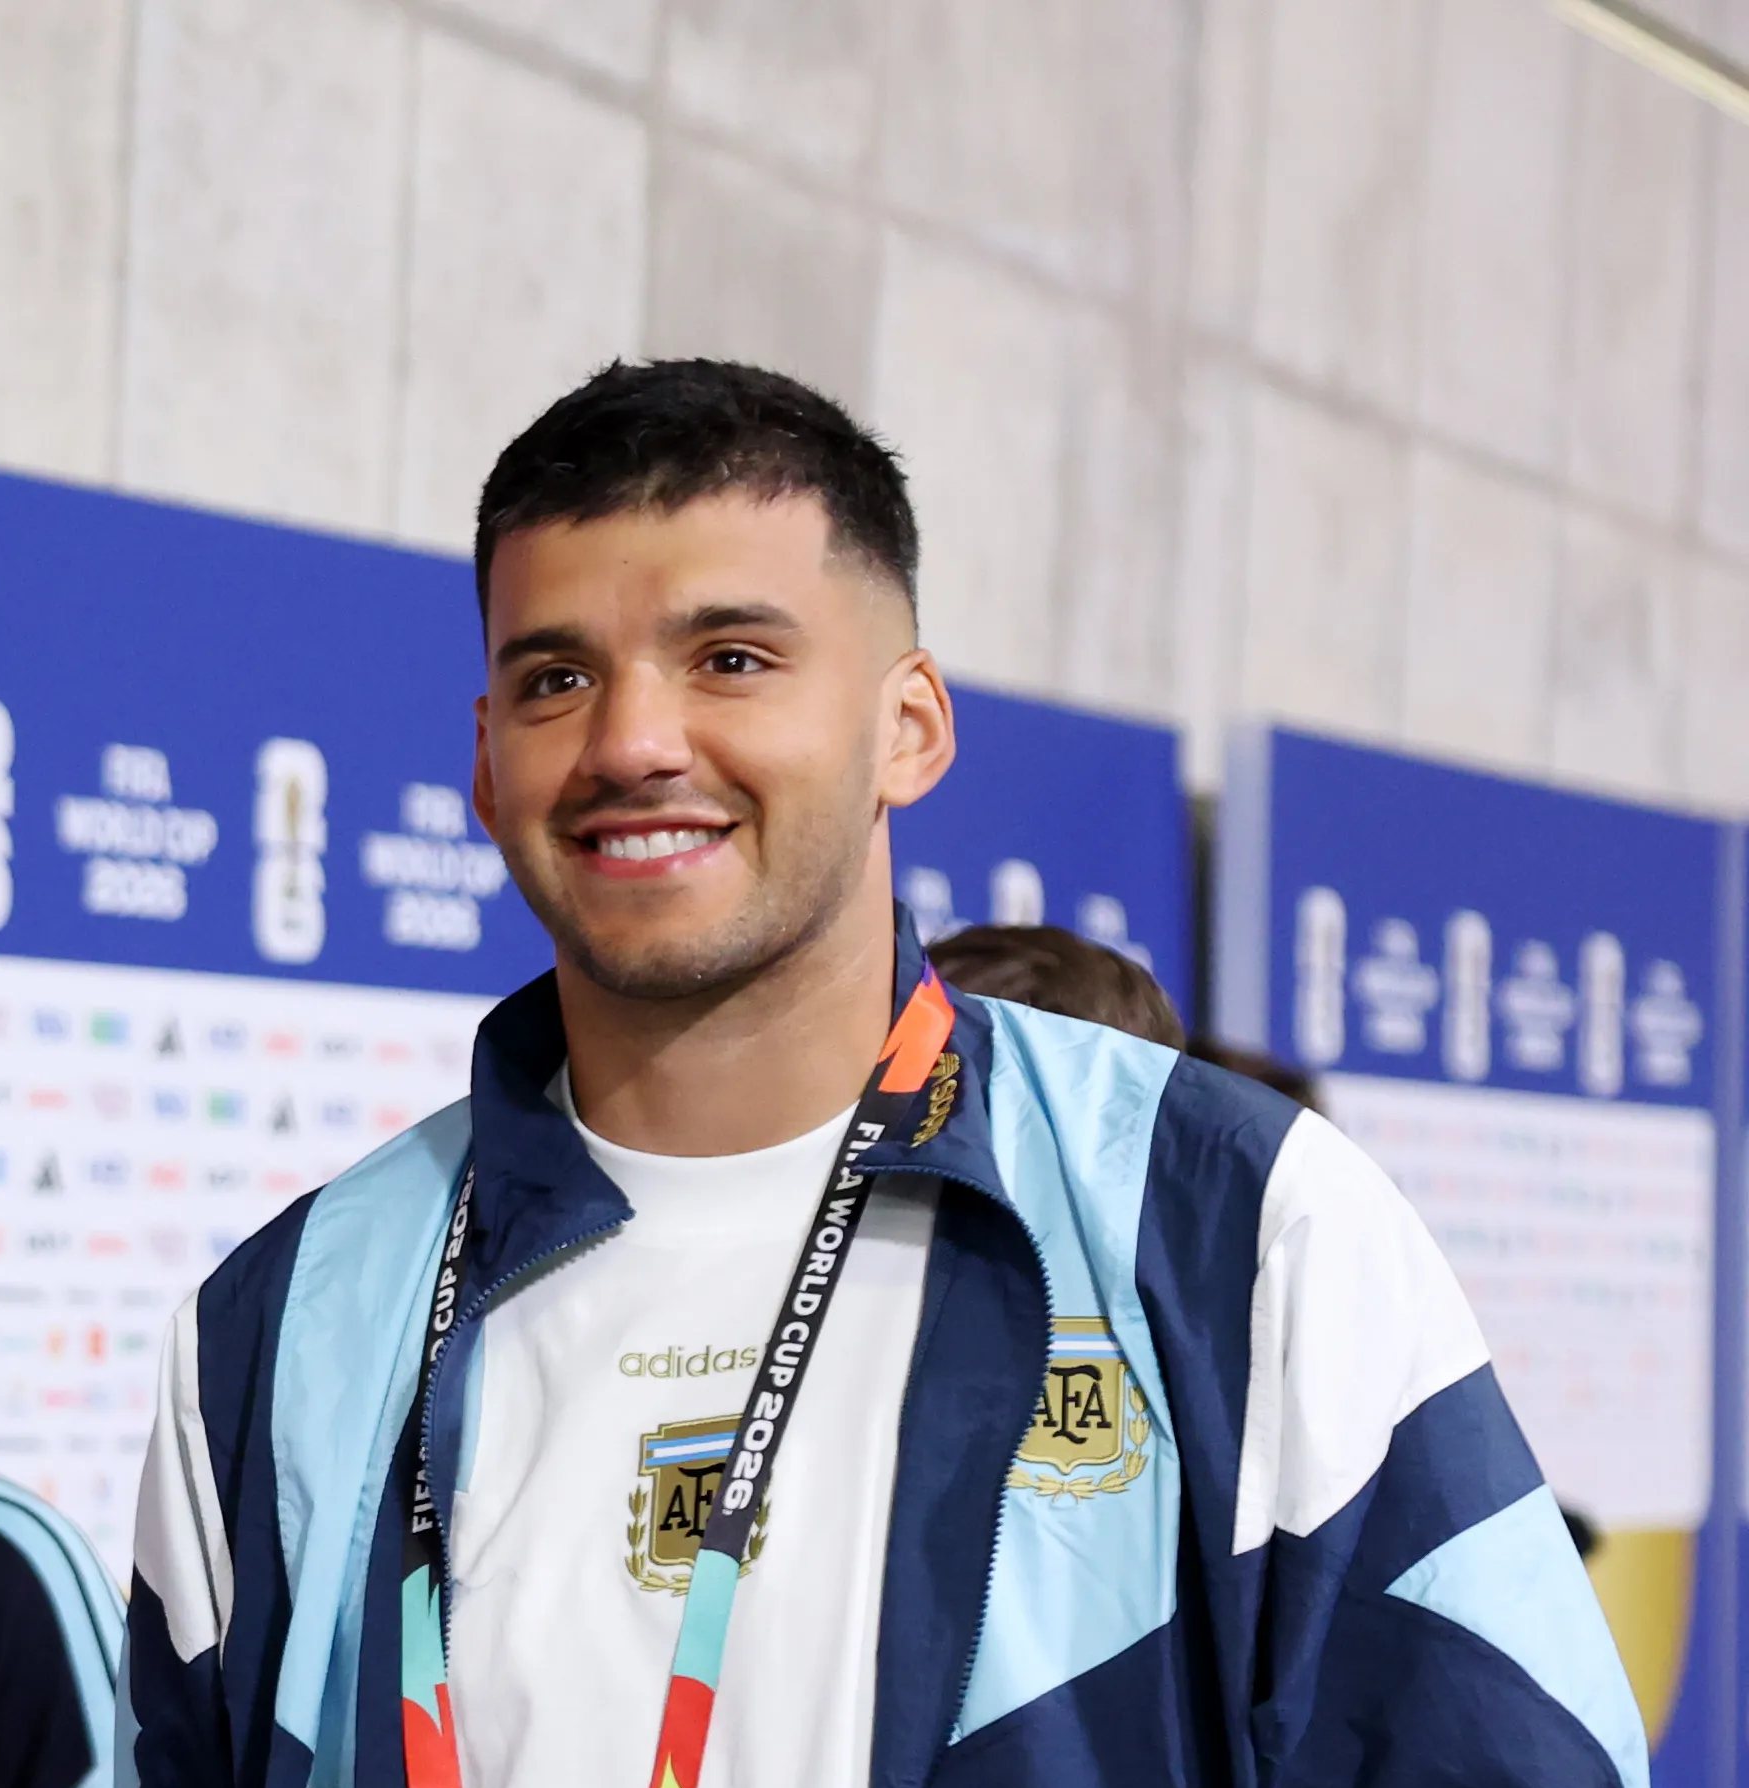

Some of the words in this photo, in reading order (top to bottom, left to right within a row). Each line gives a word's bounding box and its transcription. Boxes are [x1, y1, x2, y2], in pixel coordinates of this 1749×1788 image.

[793, 1197, 856, 1315] WORLD
[433, 1271, 458, 1332] CUP
[619, 1345, 757, 1378] adidas
[768, 1322, 810, 1388] CUP
[724, 1391, 784, 1514] 2026
